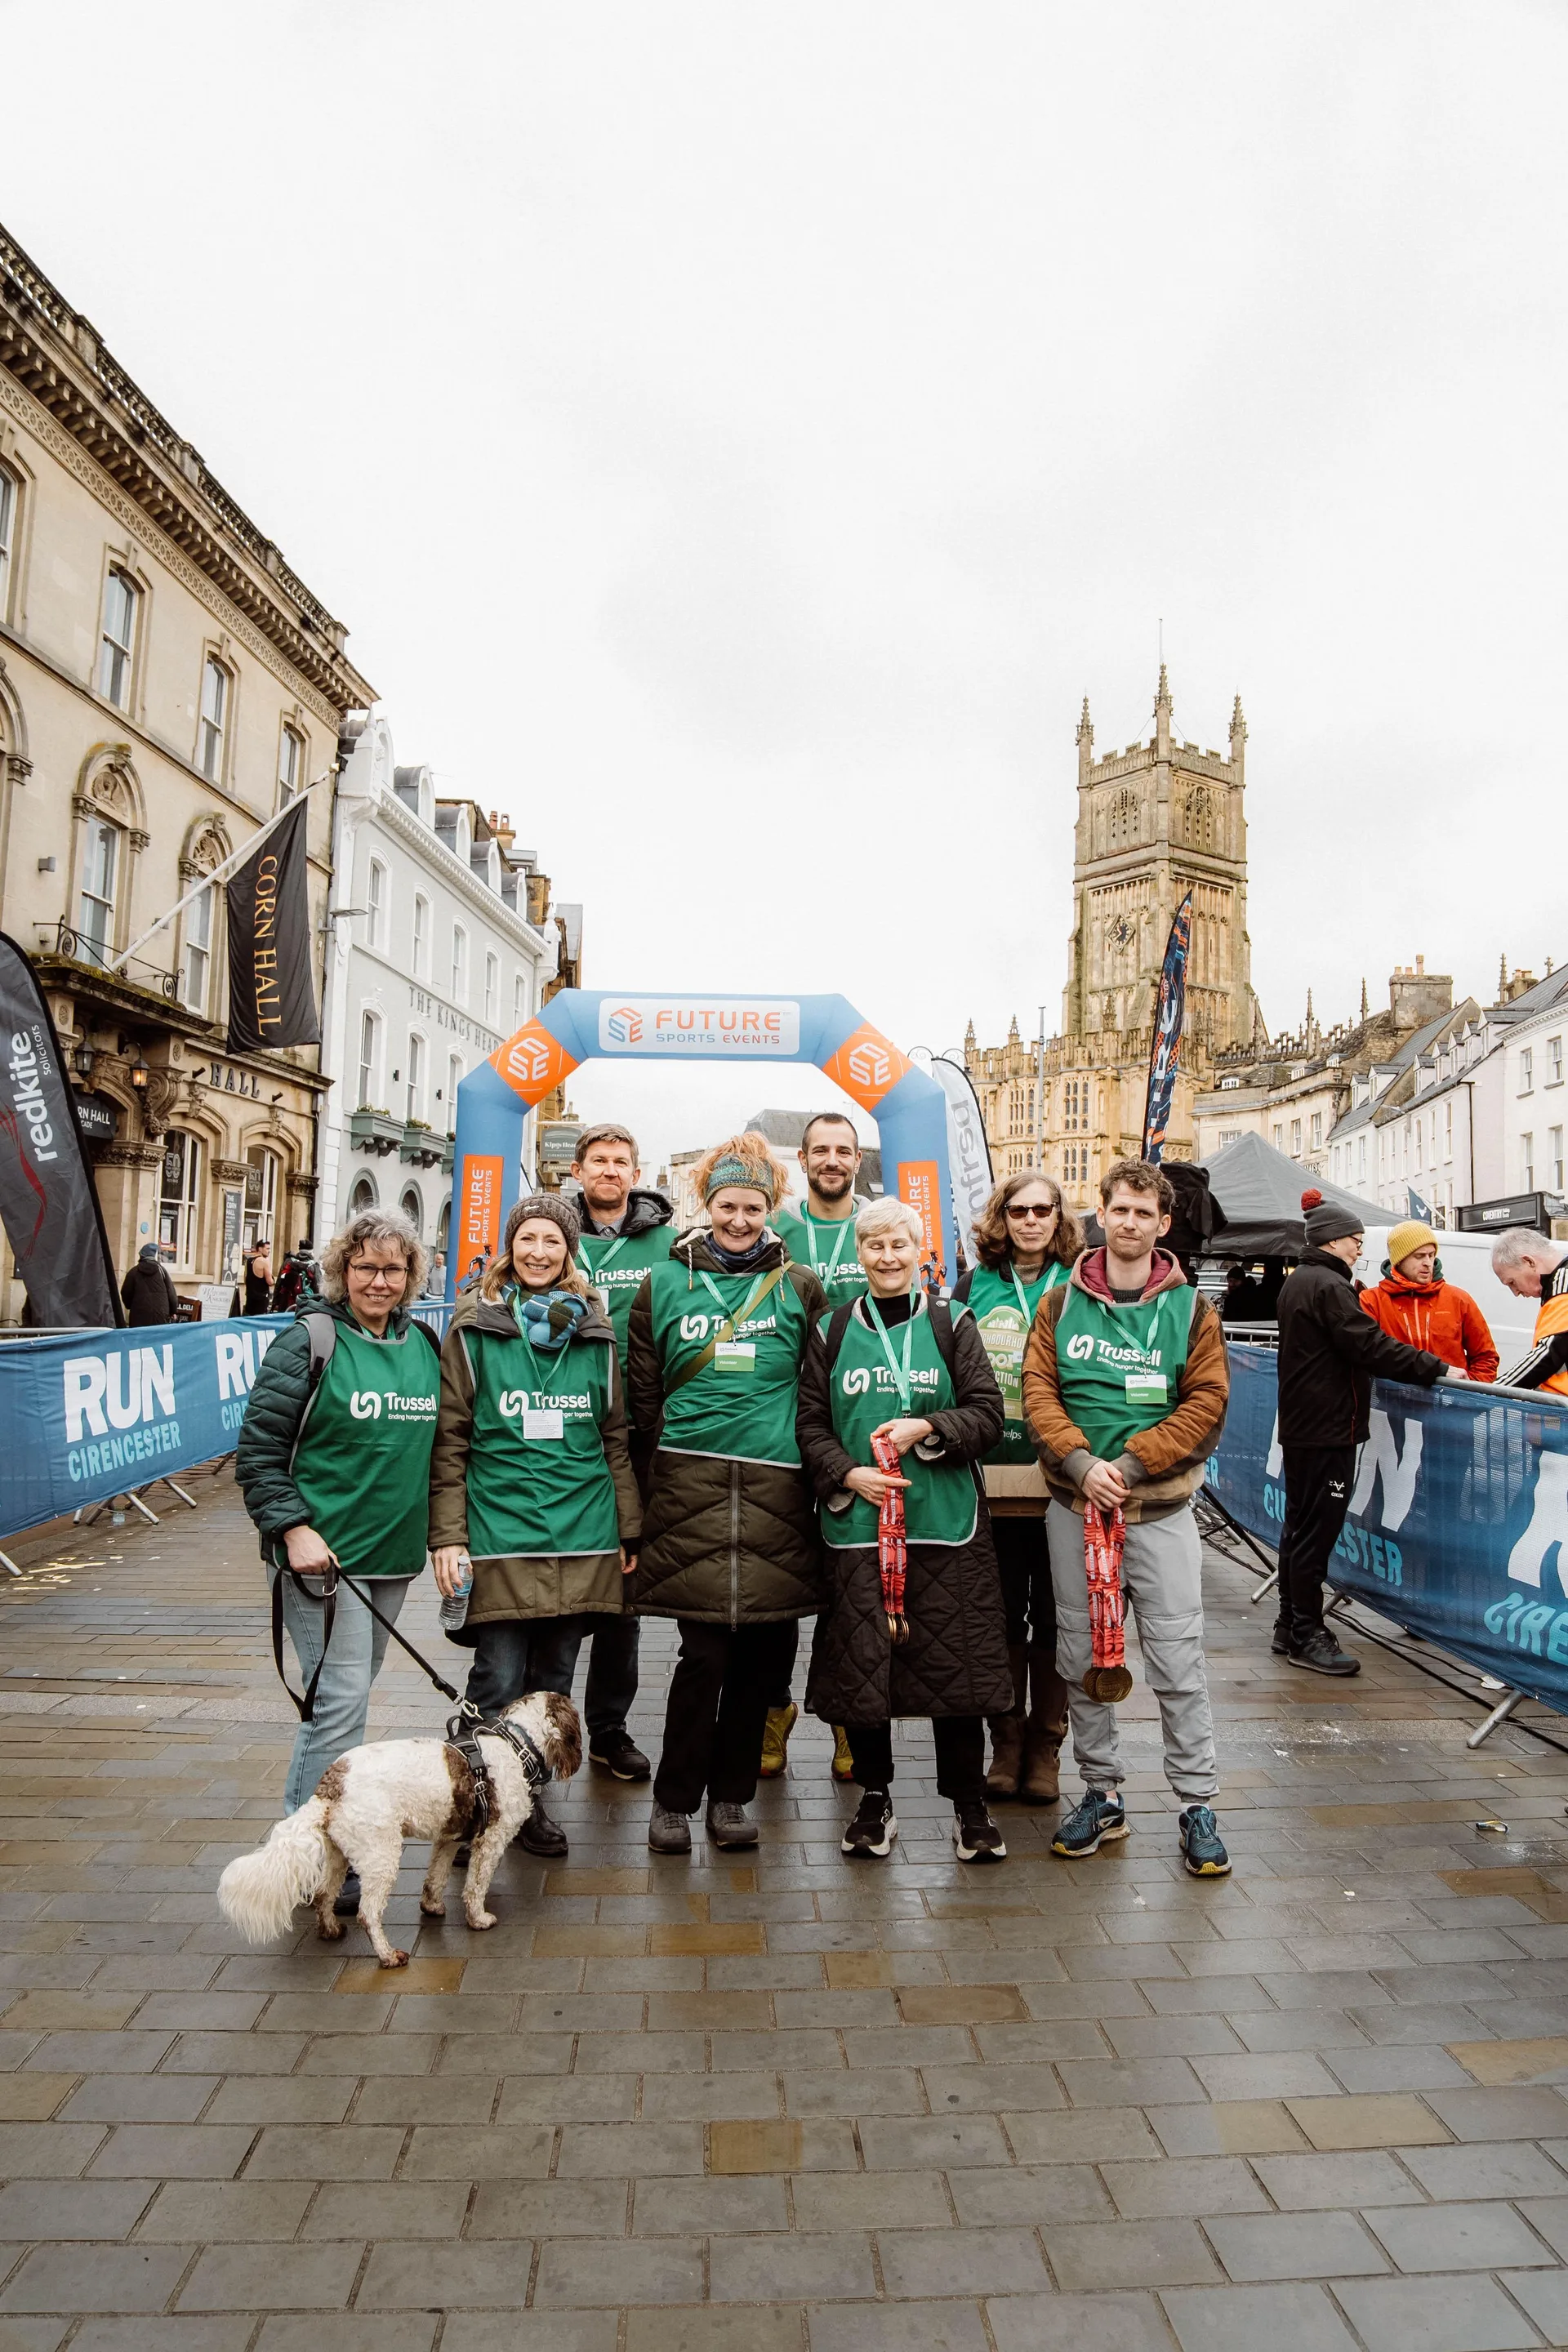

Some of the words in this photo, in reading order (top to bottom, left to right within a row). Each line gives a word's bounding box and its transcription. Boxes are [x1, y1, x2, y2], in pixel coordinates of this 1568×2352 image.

[254, 855, 278, 938] CORN
[254, 947, 282, 1036] HALL
[409, 986, 431, 1018] THE
[438, 1004, 470, 1041] KINGS
[656, 1010, 781, 1031] FUTURE
[31, 1024, 51, 1076] solicitors
[656, 1033, 715, 1043] SPORTS
[723, 1034, 780, 1044] EVENTS
[9, 1031, 58, 1162] redkite
[210, 1062, 260, 1098] HALL
[78, 1106, 89, 1120] RN
[91, 1109, 110, 1125] HALL
[484, 1169, 492, 1205] EVENTS
[922, 1175, 931, 1210] EVENTS
[468, 1169, 484, 1244] FUTURE
[482, 1208, 491, 1244] SPORTS
[925, 1214, 933, 1250] SPORTS
[711, 1314, 776, 1332] Trssell
[1115, 1363, 1134, 1371] hunger
[64, 1344, 176, 1443] RUN
[384, 1392, 437, 1412] Trussell
[913, 1386, 936, 1394] together
[68, 1420, 181, 1482] CIRENCESTER
